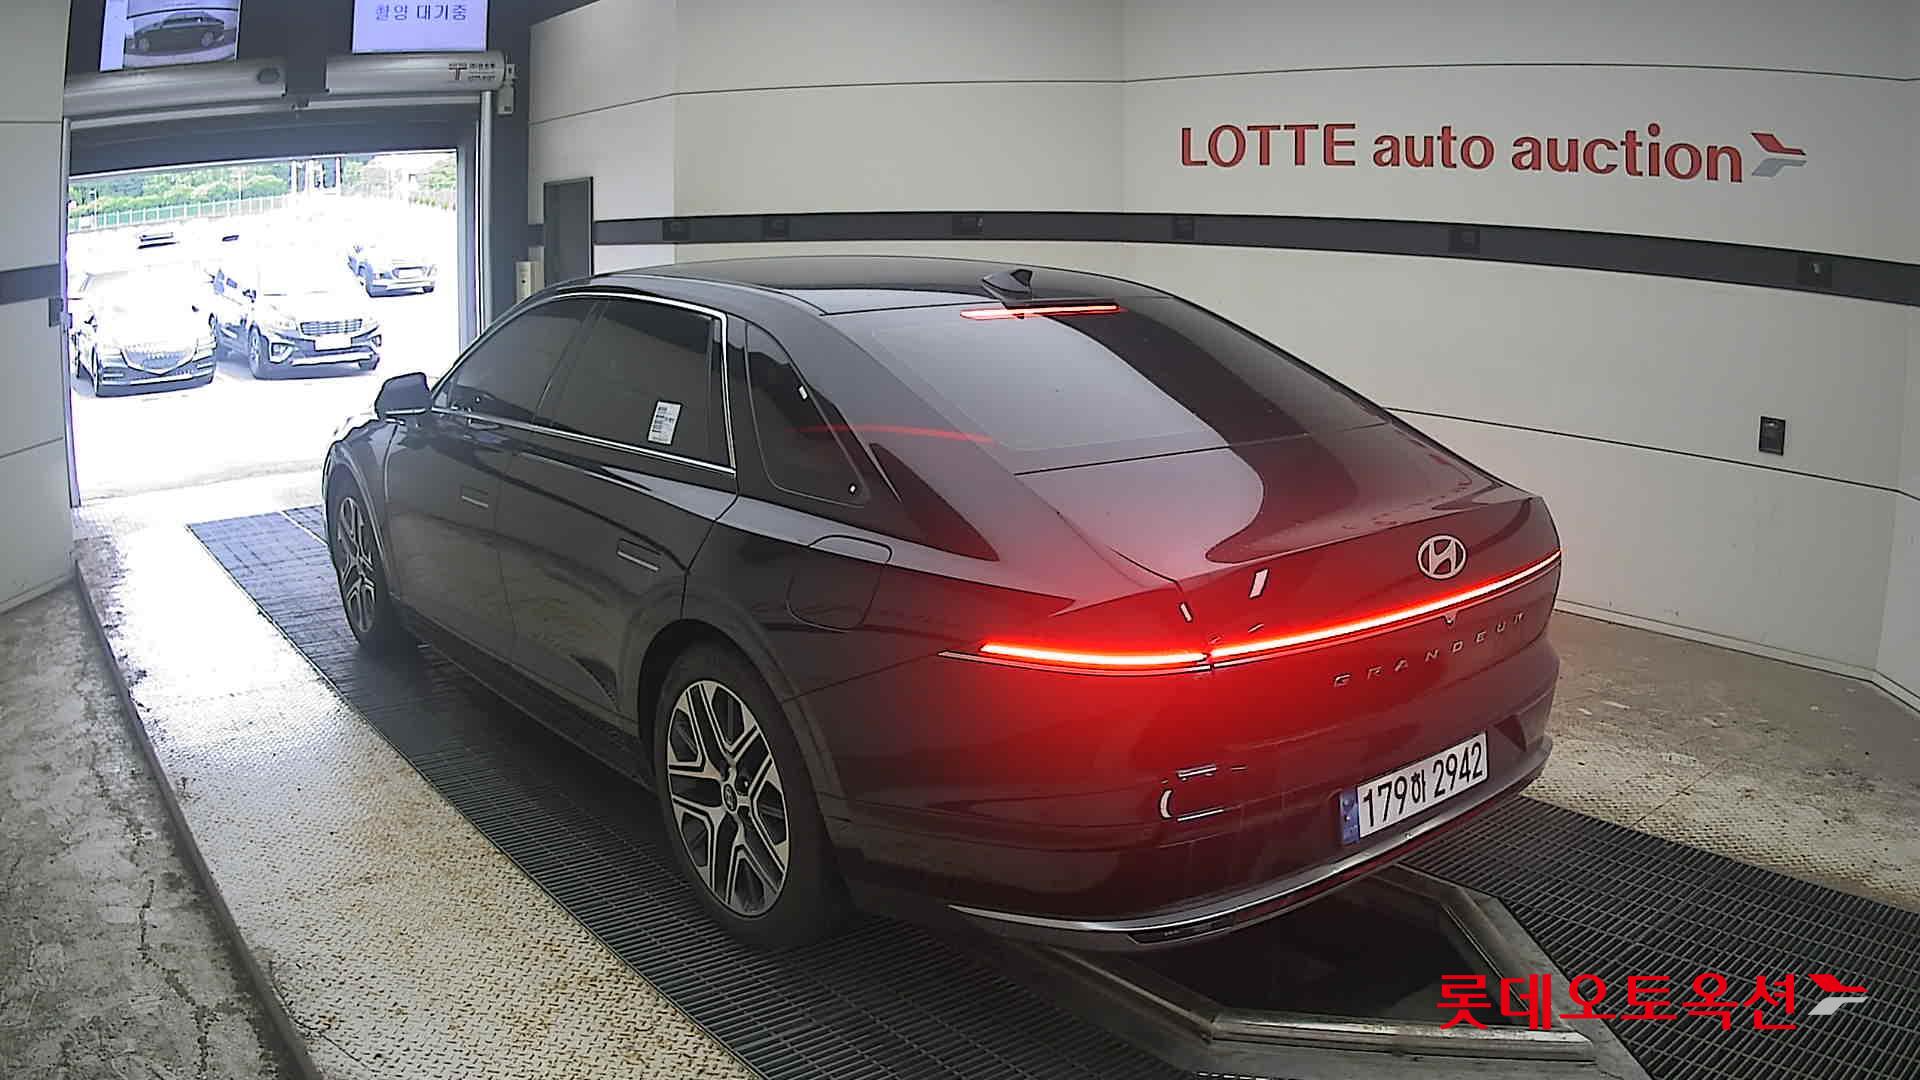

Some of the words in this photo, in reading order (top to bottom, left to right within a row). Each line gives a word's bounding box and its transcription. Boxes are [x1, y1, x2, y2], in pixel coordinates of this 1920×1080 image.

[416, 4, 467, 21] 대기중
[1181, 123, 1356, 167] LOTTE
[1372, 125, 1495, 169] auto
[1511, 123, 1743, 183] auction
[1333, 612, 1525, 688] GRANDEUR
[1363, 769, 1426, 827] 179하
[1432, 742, 1483, 798] 2942
